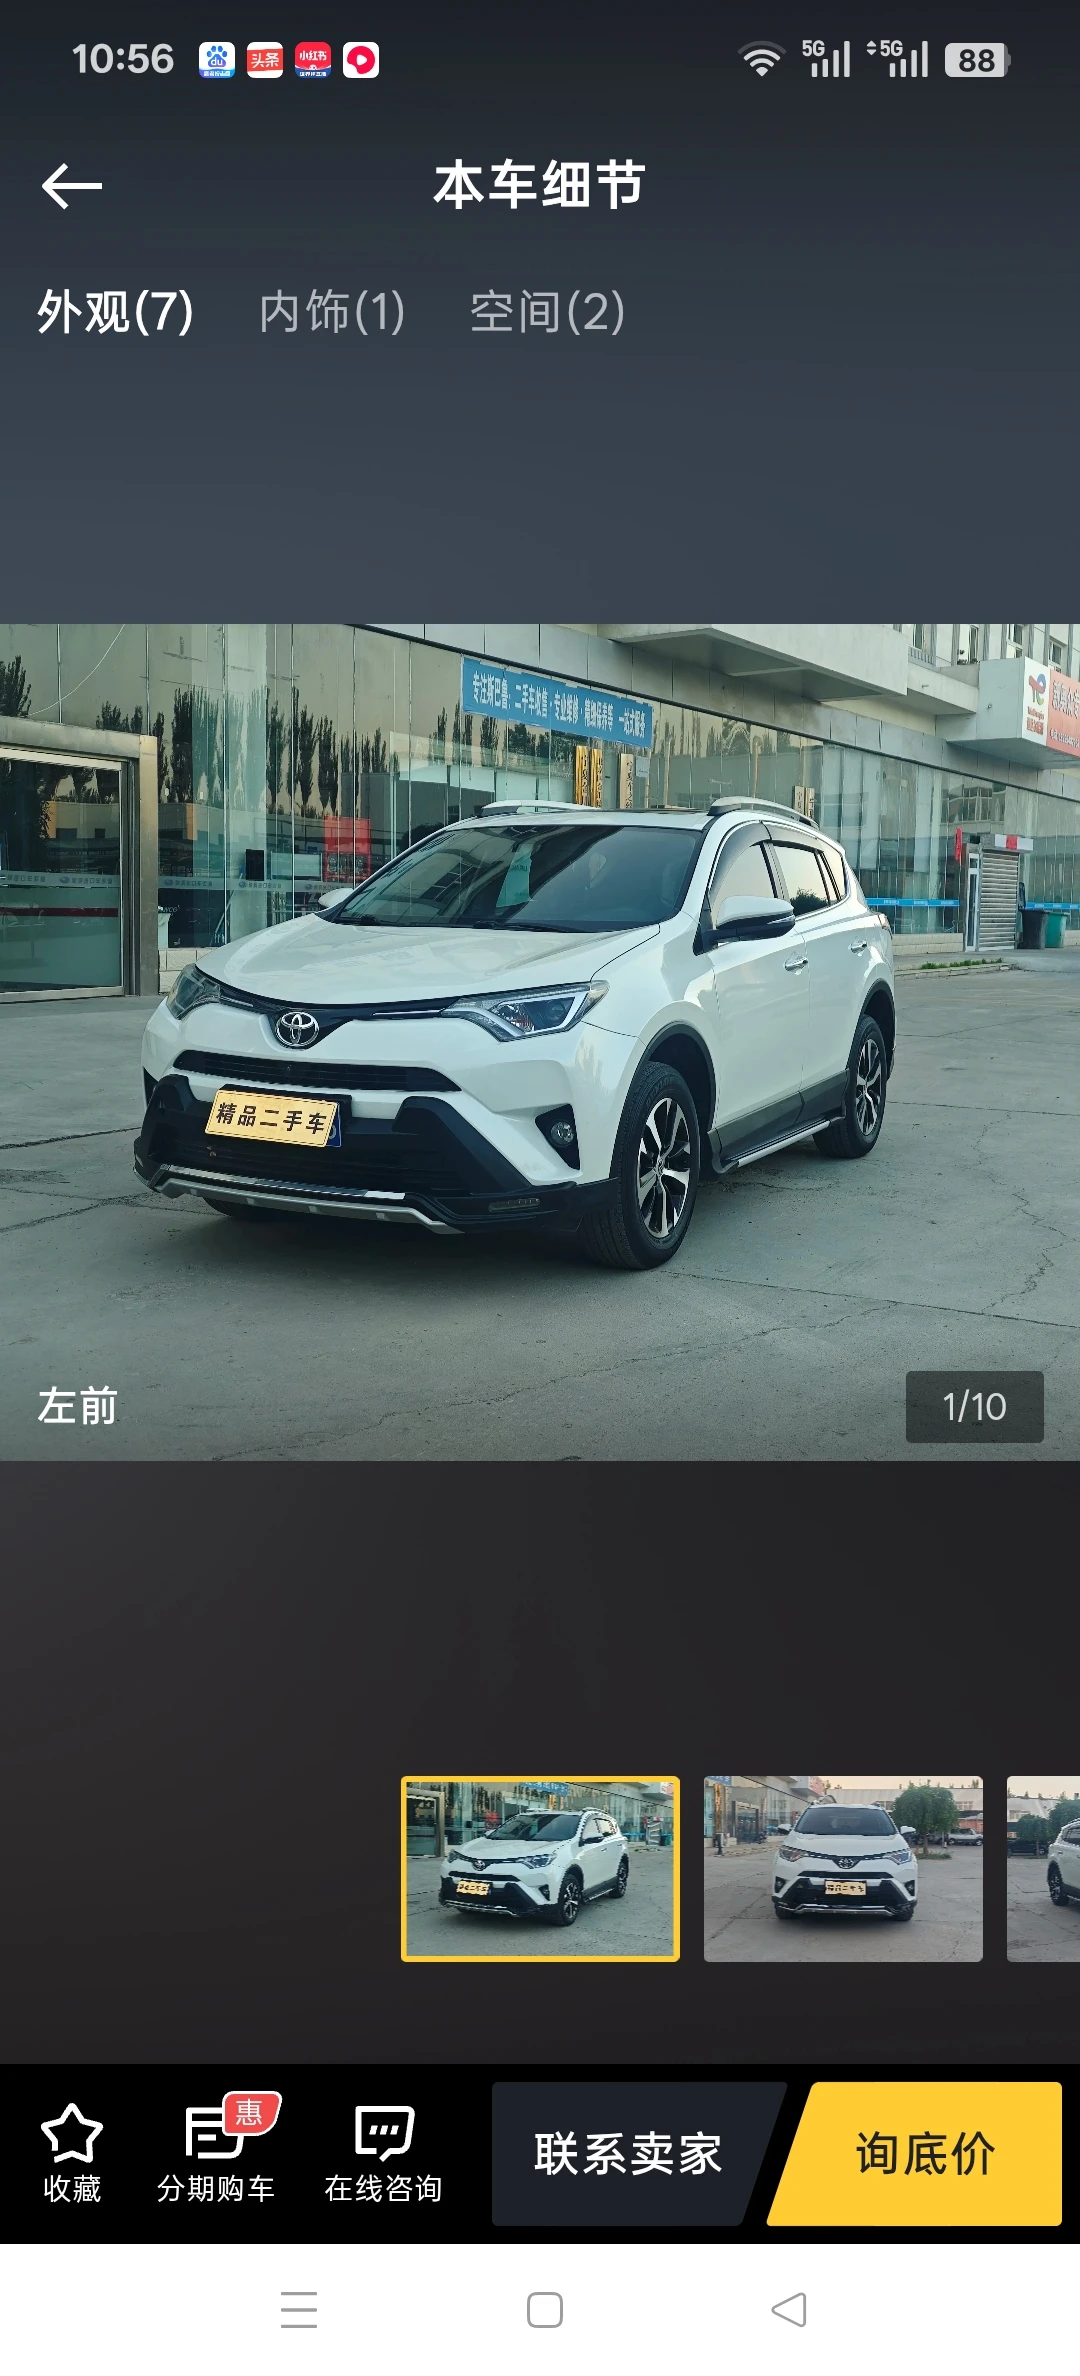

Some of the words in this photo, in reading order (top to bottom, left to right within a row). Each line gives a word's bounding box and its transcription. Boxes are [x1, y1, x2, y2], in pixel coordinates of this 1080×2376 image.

[73, 44, 174, 74] 10:56
[210, 56, 223, 66] du
[251, 53, 280, 69] 头条
[299, 50, 327, 61] 小红书
[802, 40, 825, 57] 5G
[880, 40, 903, 57] 5G
[958, 48, 996, 73] 88
[433, 158, 646, 210] 本车细节
[36, 289, 193, 337] 外观(7)
[260, 288, 405, 336] 内饰(1)
[470, 288, 625, 336] 空间(2)
[216, 1102, 327, 1135] 精品二手车
[235, 2098, 263, 2126] 惠
[534, 2131, 723, 2176] 联系卖家
[856, 2131, 996, 2176] 询底价
[43, 2174, 102, 2203] 收藏
[157, 2174, 275, 2203] 分期购车
[324, 2174, 442, 2203] 在线咨询
